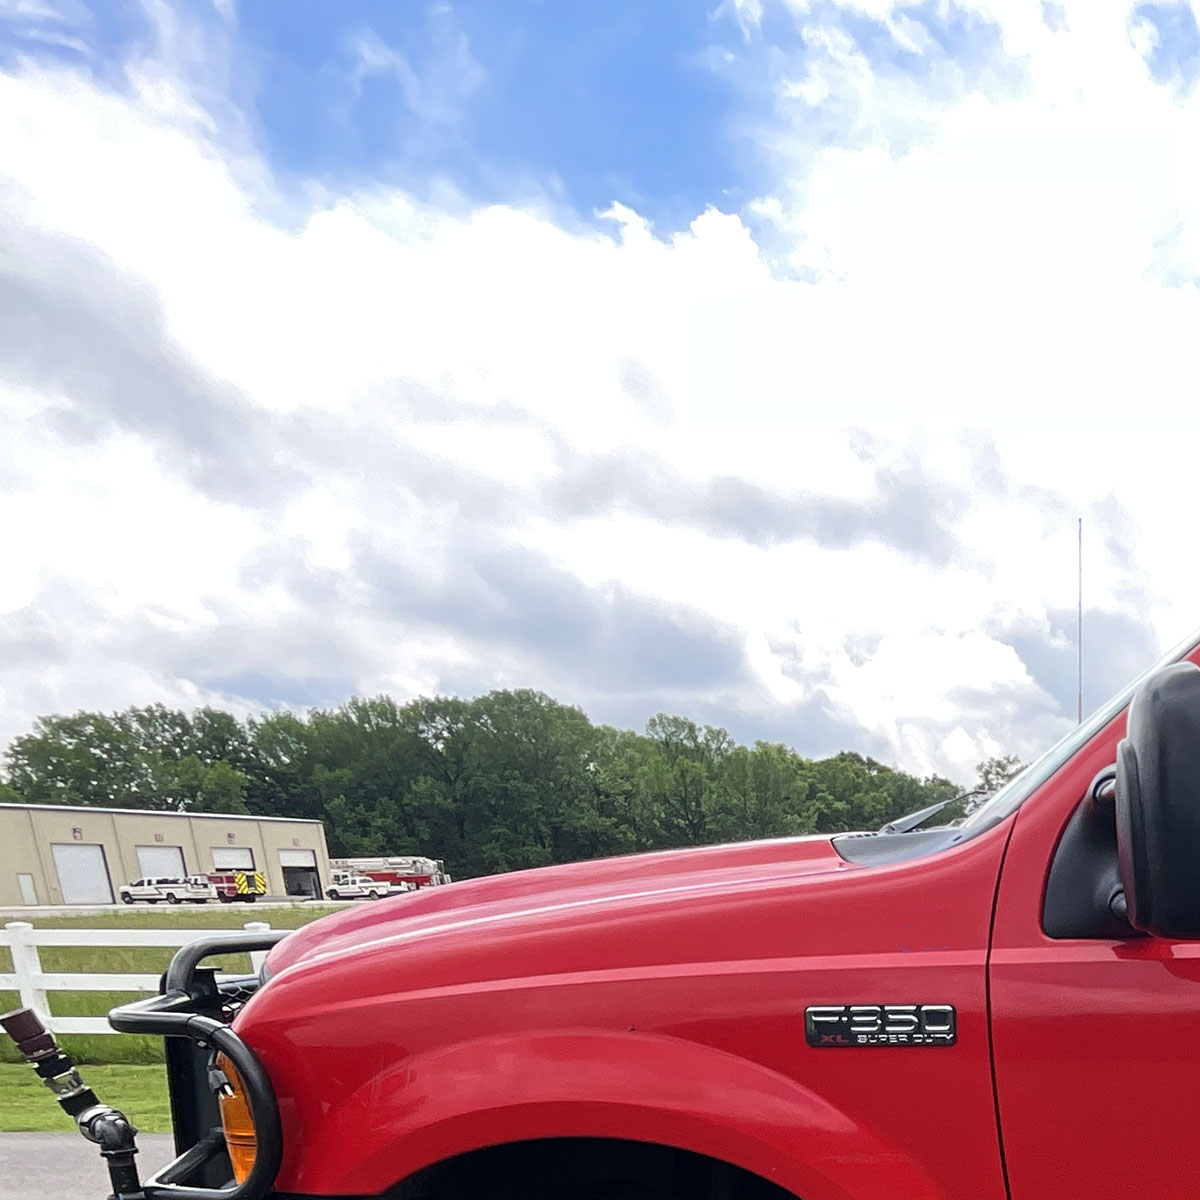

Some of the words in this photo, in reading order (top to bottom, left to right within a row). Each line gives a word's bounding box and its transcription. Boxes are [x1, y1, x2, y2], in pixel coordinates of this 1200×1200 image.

[805, 1005, 954, 1034] F-350
[820, 1034, 849, 1043] XL
[857, 1034, 908, 1043] SUPER
[912, 1034, 954, 1043] DUTY
